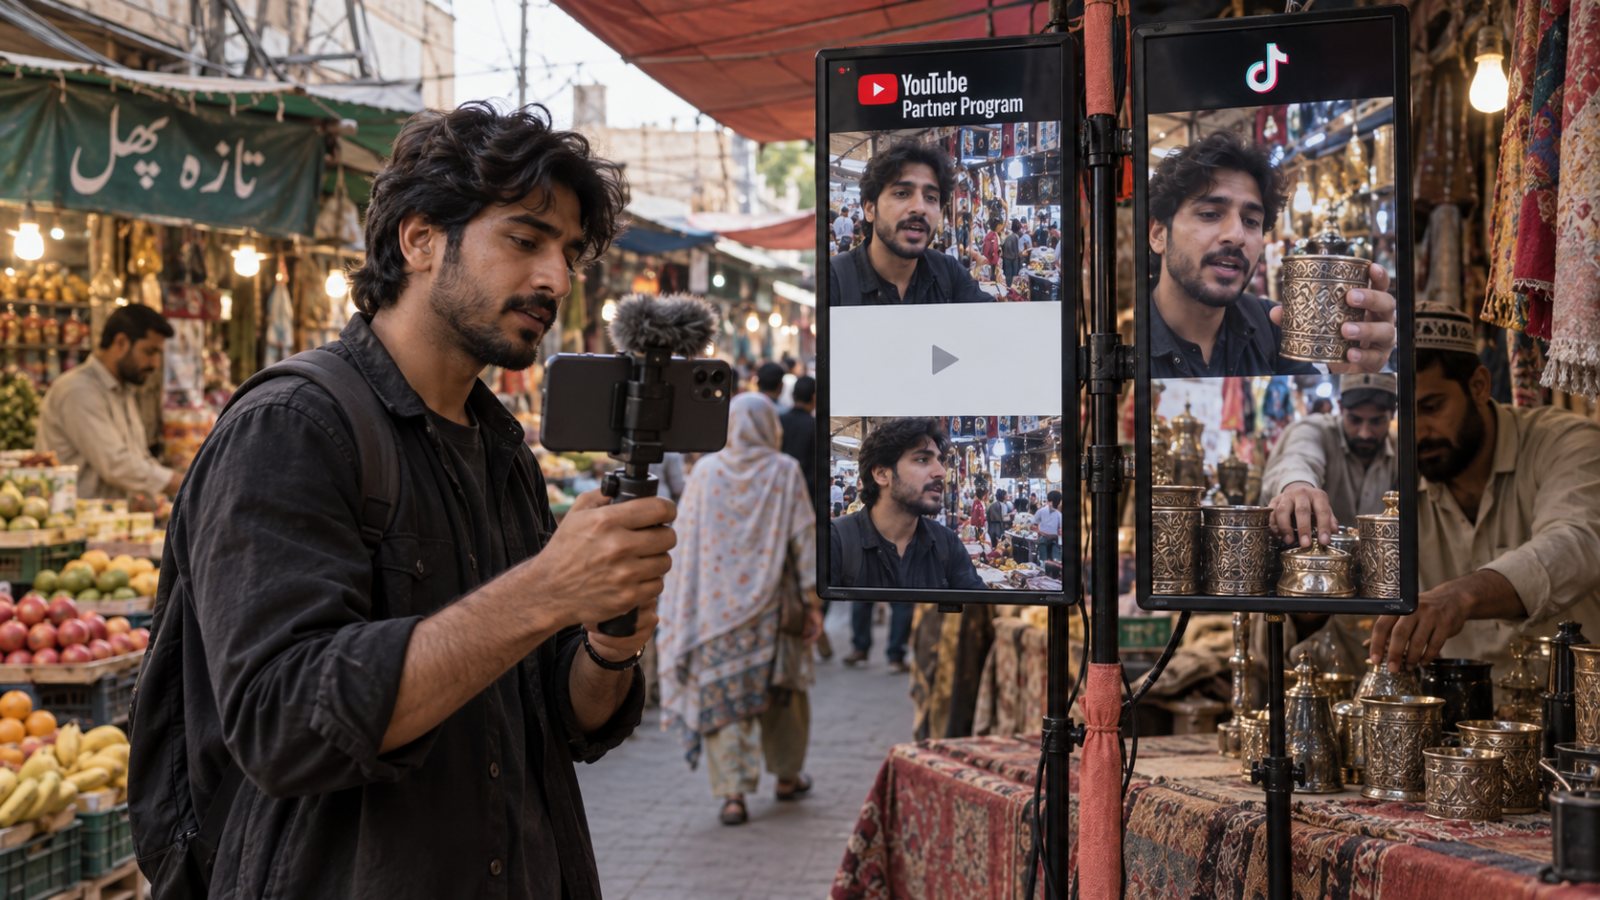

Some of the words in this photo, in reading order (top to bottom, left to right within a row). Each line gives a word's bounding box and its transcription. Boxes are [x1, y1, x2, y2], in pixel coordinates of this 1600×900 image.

[901, 71, 968, 97] YouTube
[902, 99, 957, 119] Partner
[960, 97, 1023, 119] Program
[70, 104, 169, 195] پھل
